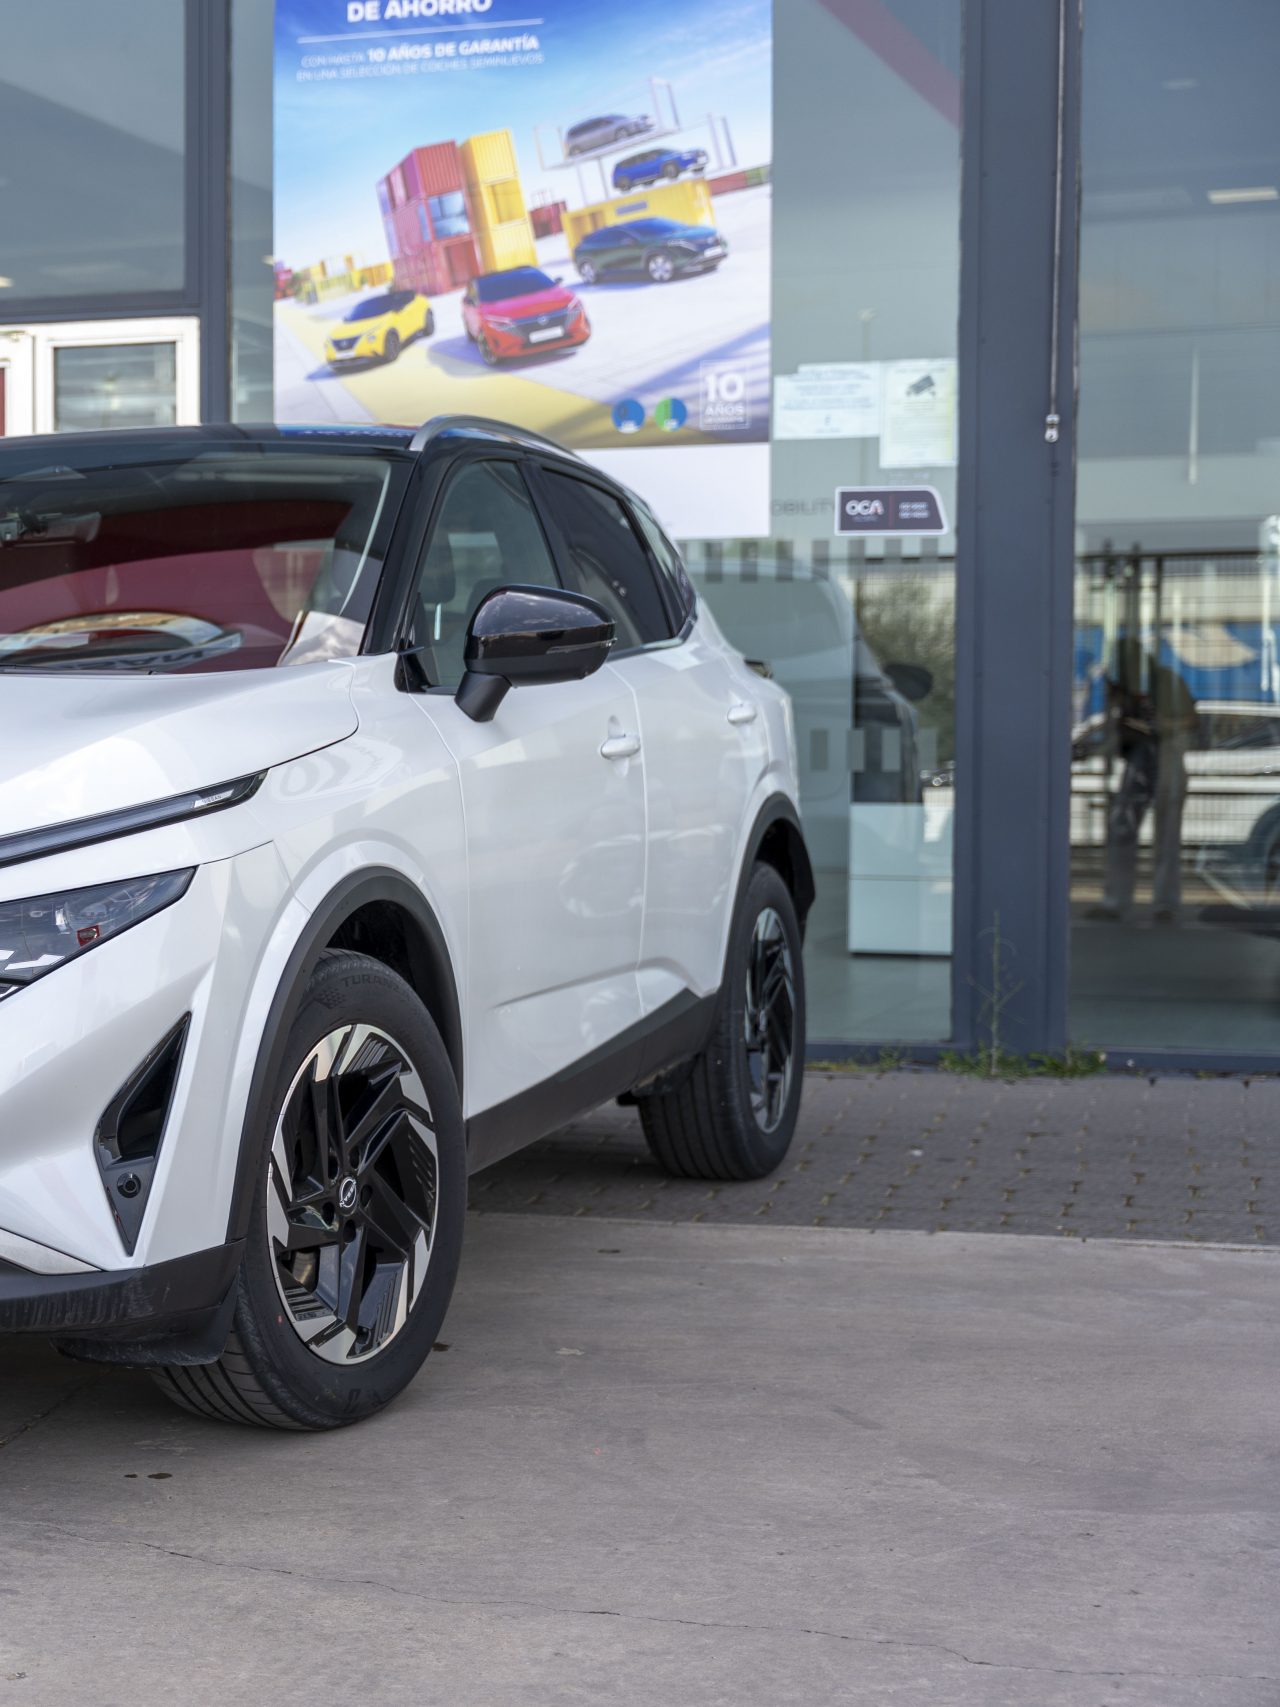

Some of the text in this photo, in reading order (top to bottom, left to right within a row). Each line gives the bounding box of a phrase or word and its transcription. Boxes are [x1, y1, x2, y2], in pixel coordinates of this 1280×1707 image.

[346, 0, 493, 23] DE AHORRO
[367, 48, 386, 62] 10
[387, 43, 432, 62] AÑOS
[435, 42, 456, 57] DE
[460, 34, 538, 54] GARANTÍA
[705, 373, 744, 402] 10
[704, 401, 745, 417] AÑOS
[771, 499, 835, 517] OBILIT
[845, 500, 884, 515] OCA
